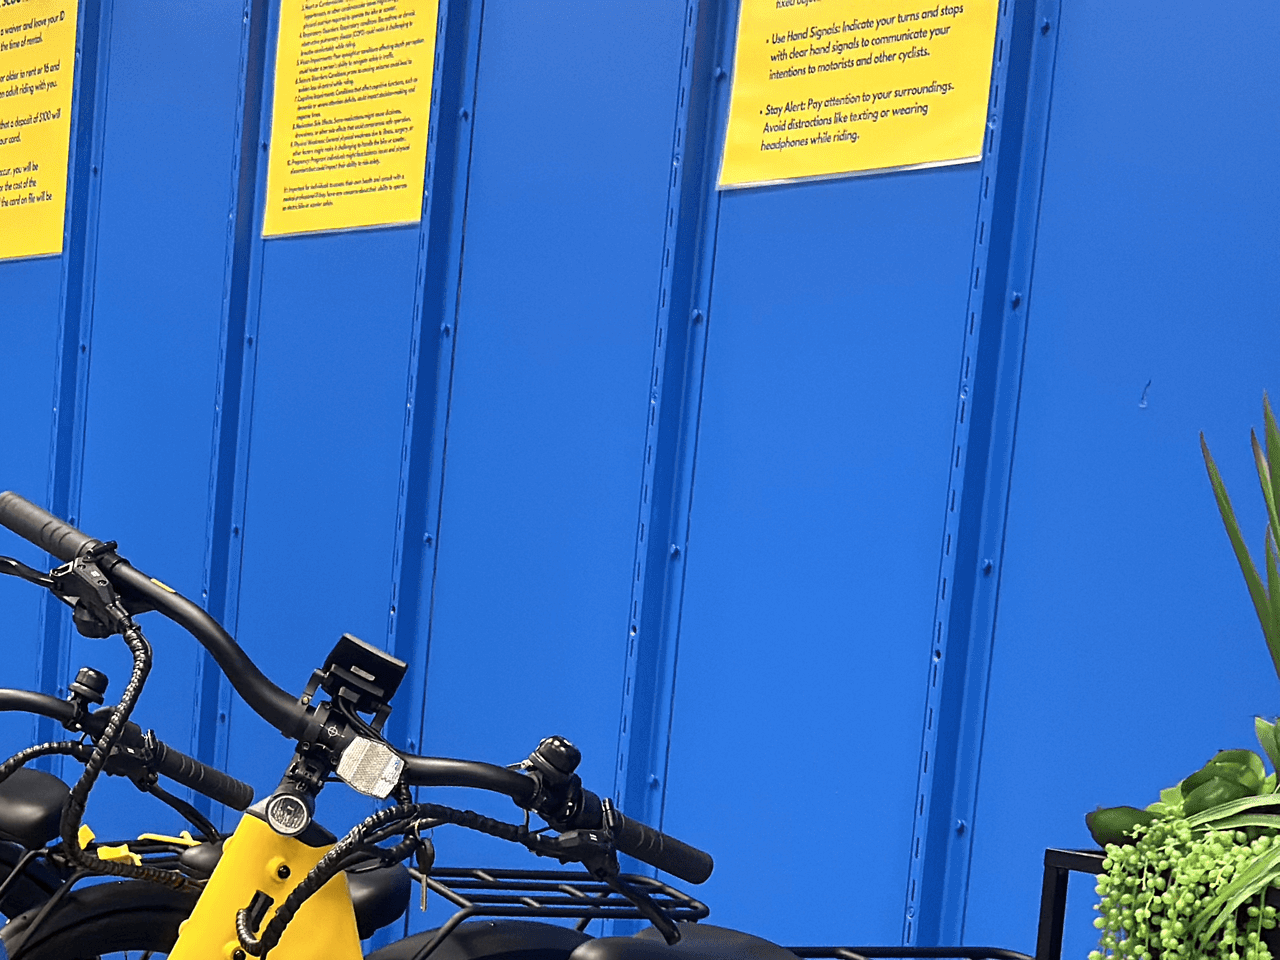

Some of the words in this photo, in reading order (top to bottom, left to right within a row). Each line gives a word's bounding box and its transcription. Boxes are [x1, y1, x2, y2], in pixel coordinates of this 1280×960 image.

[5, 24, 21, 34] waiver
[23, 18, 33, 30] and
[34, 18, 46, 28] leave
[48, 15, 58, 27] your
[772, 33, 785, 44] Use
[787, 27, 808, 42] Hand
[810, 23, 840, 40] Signals:
[842, 19, 874, 32] Indicate
[876, 16, 895, 30] your
[898, 12, 919, 23] turns
[921, 6, 939, 19] and
[940, 5, 963, 18] stops
[9, 40, 20, 49] time
[27, 32, 43, 45] rental.
[771, 49, 788, 61] with
[789, 47, 808, 59] clear
[810, 41, 831, 56] hand
[832, 37, 859, 54] signals
[861, 38, 870, 47] to
[871, 28, 928, 46] communicate
[929, 26, 951, 40] your
[6, 71, 18, 81] older
[26, 67, 36, 77] rent
[50, 60, 60, 72] and
[769, 66, 806, 79] intentions
[808, 64, 816, 74] to
[818, 58, 854, 72] motorists
[856, 53, 872, 66] and
[874, 51, 896, 64] other
[898, 46, 930, 63] cyclists.
[6, 86, 18, 97] adult
[20, 83, 34, 95] riding
[35, 80, 46, 90] with
[47, 81, 57, 92] you.
[765, 104, 783, 117] Stay
[784, 101, 806, 113] Alert:
[807, 98, 823, 112] Pay
[824, 93, 860, 107] attention
[862, 92, 871, 102] to
[872, 91, 892, 104] your
[894, 81, 954, 98] surroundings.
[0, 120, 10, 130] that
[15, 115, 32, 127] deposit
[52, 108, 61, 119] will
[763, 120, 786, 133] Avoid
[788, 115, 832, 130] distractions
[834, 112, 848, 124] like
[850, 109, 878, 122] texting
[880, 110, 890, 118] or
[892, 102, 928, 116] wearing
[9, 132, 21, 143] card.
[761, 137, 808, 152] headphones
[810, 131, 831, 144] while
[833, 130, 859, 143] riding.
[13, 167, 21, 177] you
[23, 161, 31, 172] will
[13, 181, 22, 190] cost
[10, 195, 20, 206] card
[36, 191, 45, 202] will
